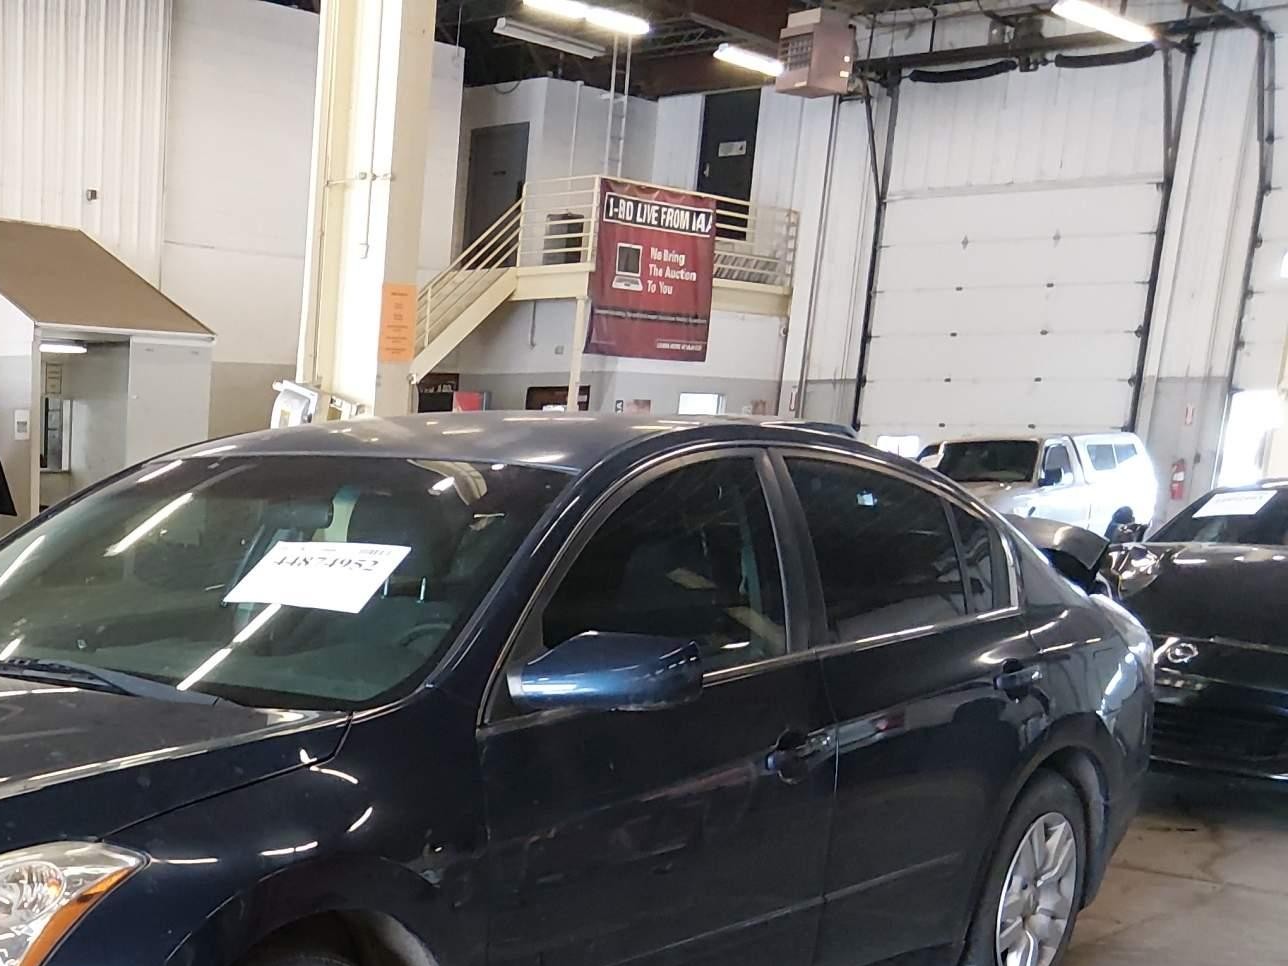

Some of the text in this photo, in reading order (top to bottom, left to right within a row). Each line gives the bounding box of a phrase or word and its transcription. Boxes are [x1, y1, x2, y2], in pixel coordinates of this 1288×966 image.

[636, 203, 660, 225] LIVE
[660, 207, 690, 230] FROM
[663, 249, 685, 267] Bring
[649, 263, 697, 282] The Auction
[647, 279, 673, 295] To You
